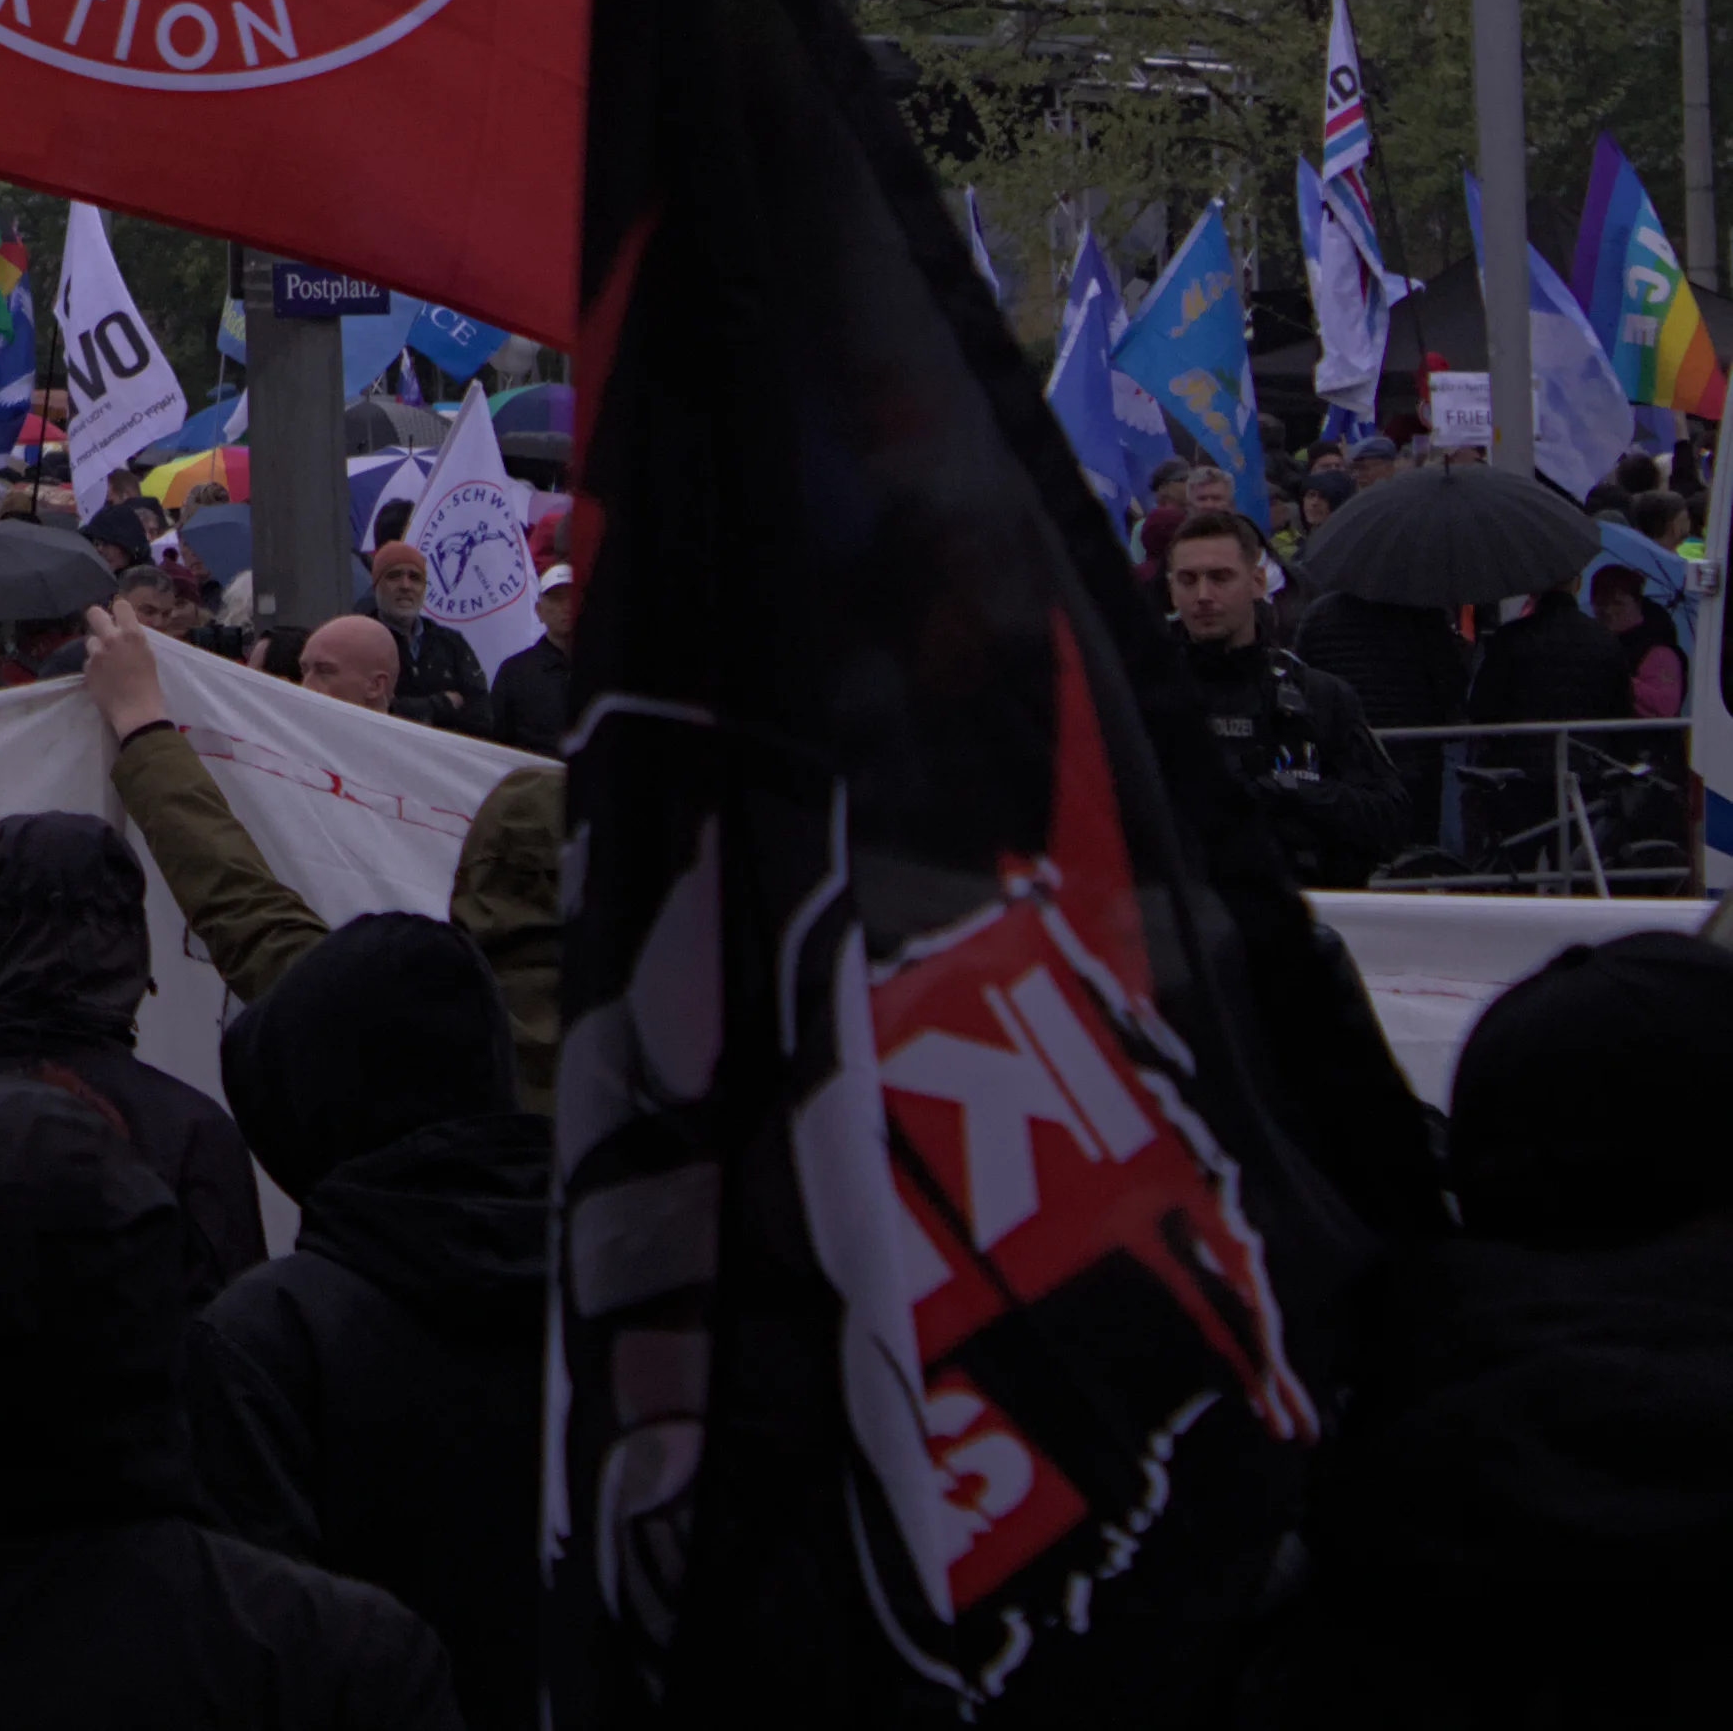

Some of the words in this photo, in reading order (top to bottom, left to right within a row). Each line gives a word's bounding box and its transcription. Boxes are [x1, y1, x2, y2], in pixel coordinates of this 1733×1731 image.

[285, 273, 381, 305] Postplatz
[1445, 409, 1492, 426] FRIE
[1211, 717, 1254, 737] OLIZEI
